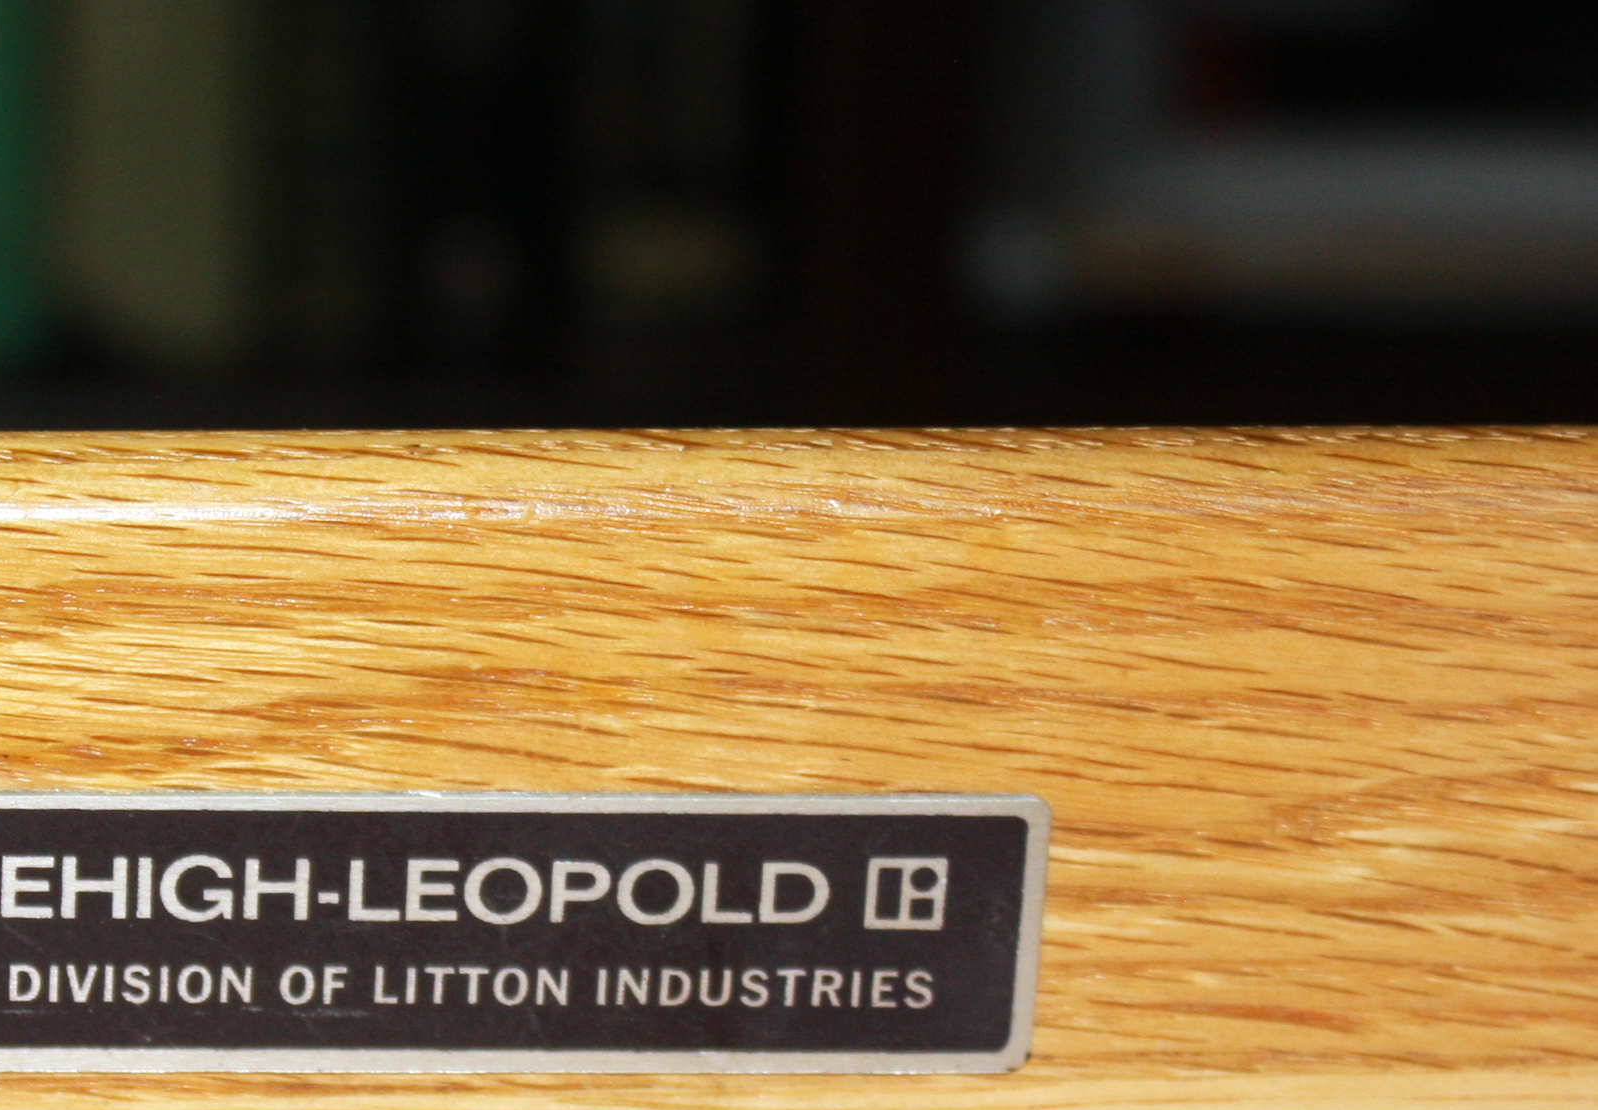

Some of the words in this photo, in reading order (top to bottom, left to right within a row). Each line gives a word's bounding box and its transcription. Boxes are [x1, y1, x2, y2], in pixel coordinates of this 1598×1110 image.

[8, 962, 253, 1005] DIVISION
[279, 964, 349, 1006] OF
[373, 965, 569, 1007] LITTON
[596, 968, 933, 1009] INDUSTRIES
